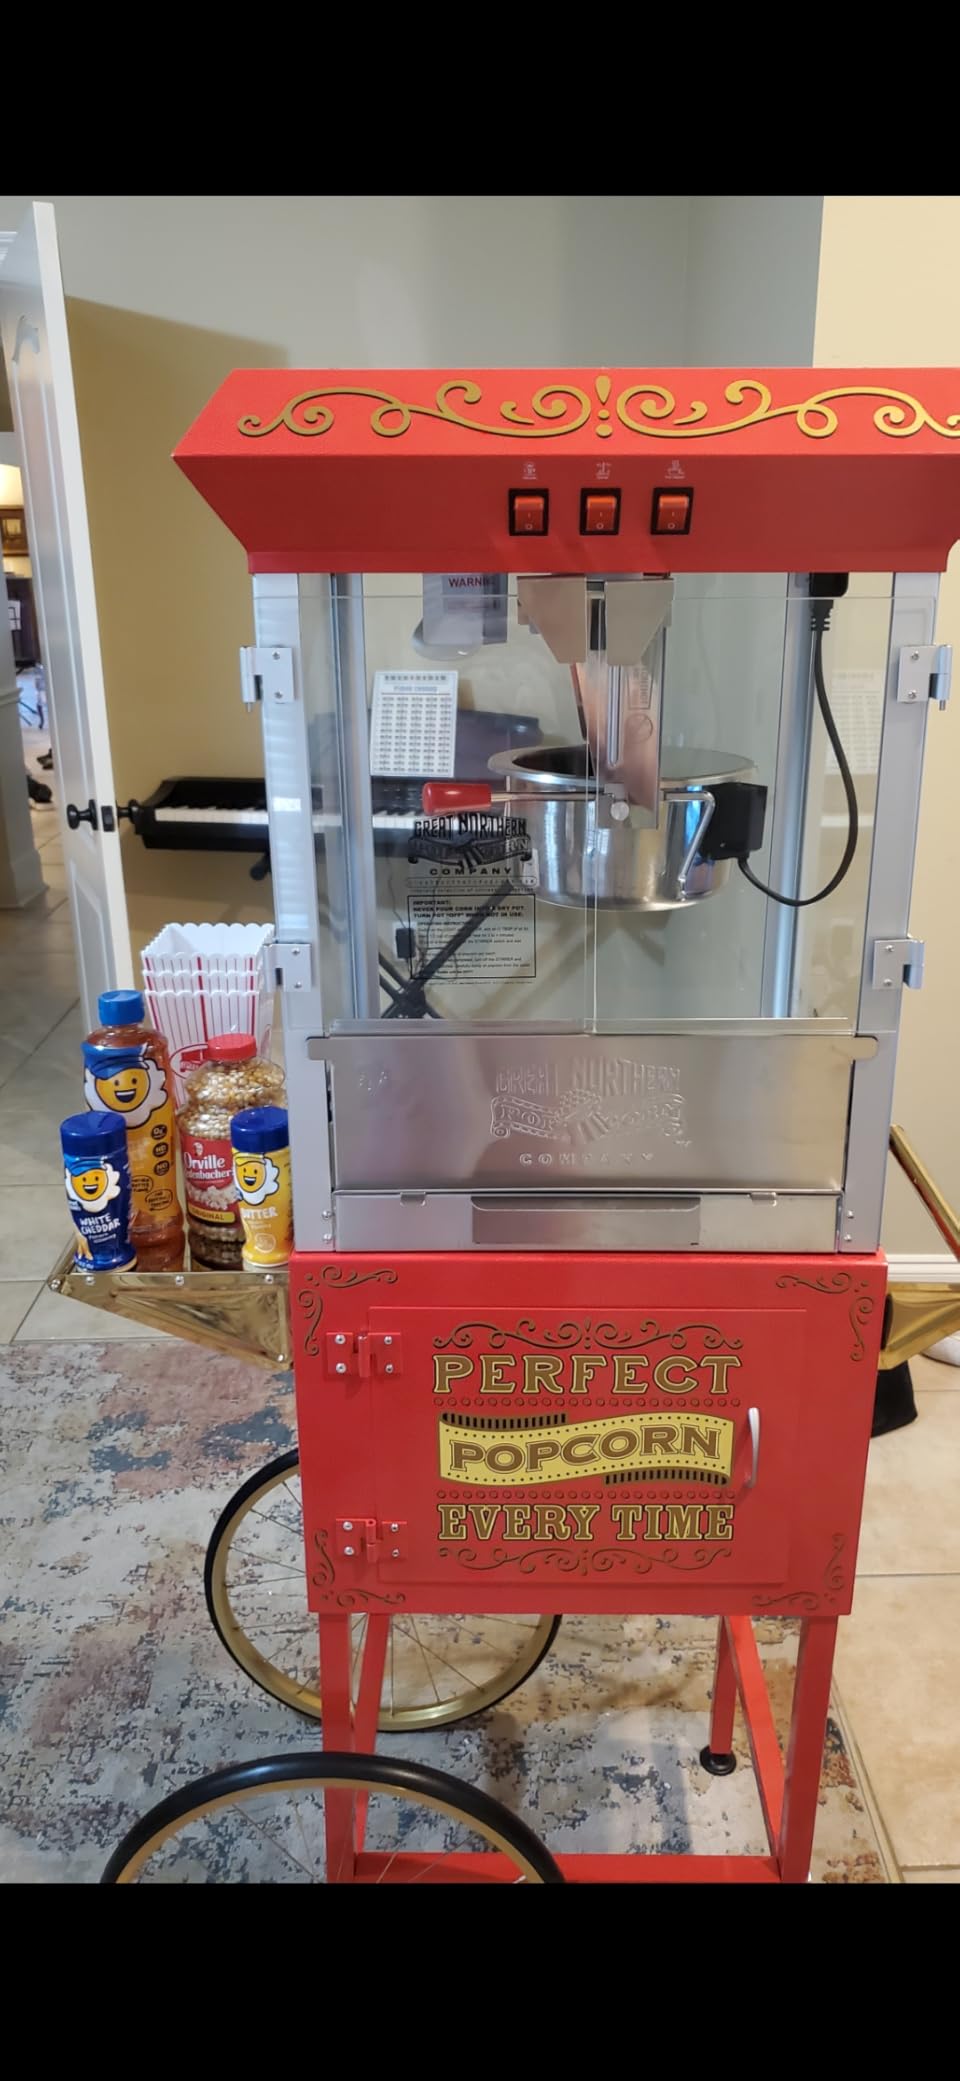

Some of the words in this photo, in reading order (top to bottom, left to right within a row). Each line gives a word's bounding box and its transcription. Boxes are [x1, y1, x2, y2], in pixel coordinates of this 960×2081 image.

[414, 815, 453, 838] GREAT
[457, 812, 527, 839] NORTHERN
[429, 867, 511, 875] COMPANY
[184, 1151, 225, 1170] Orville
[79, 1212, 112, 1226] WHITE
[80, 1217, 121, 1235] CHEDDAR
[432, 1353, 742, 1394] PERFECT
[449, 1423, 722, 1475] POPCORN
[437, 1503, 601, 1541] EVERY
[610, 1503, 735, 1541] TIME
